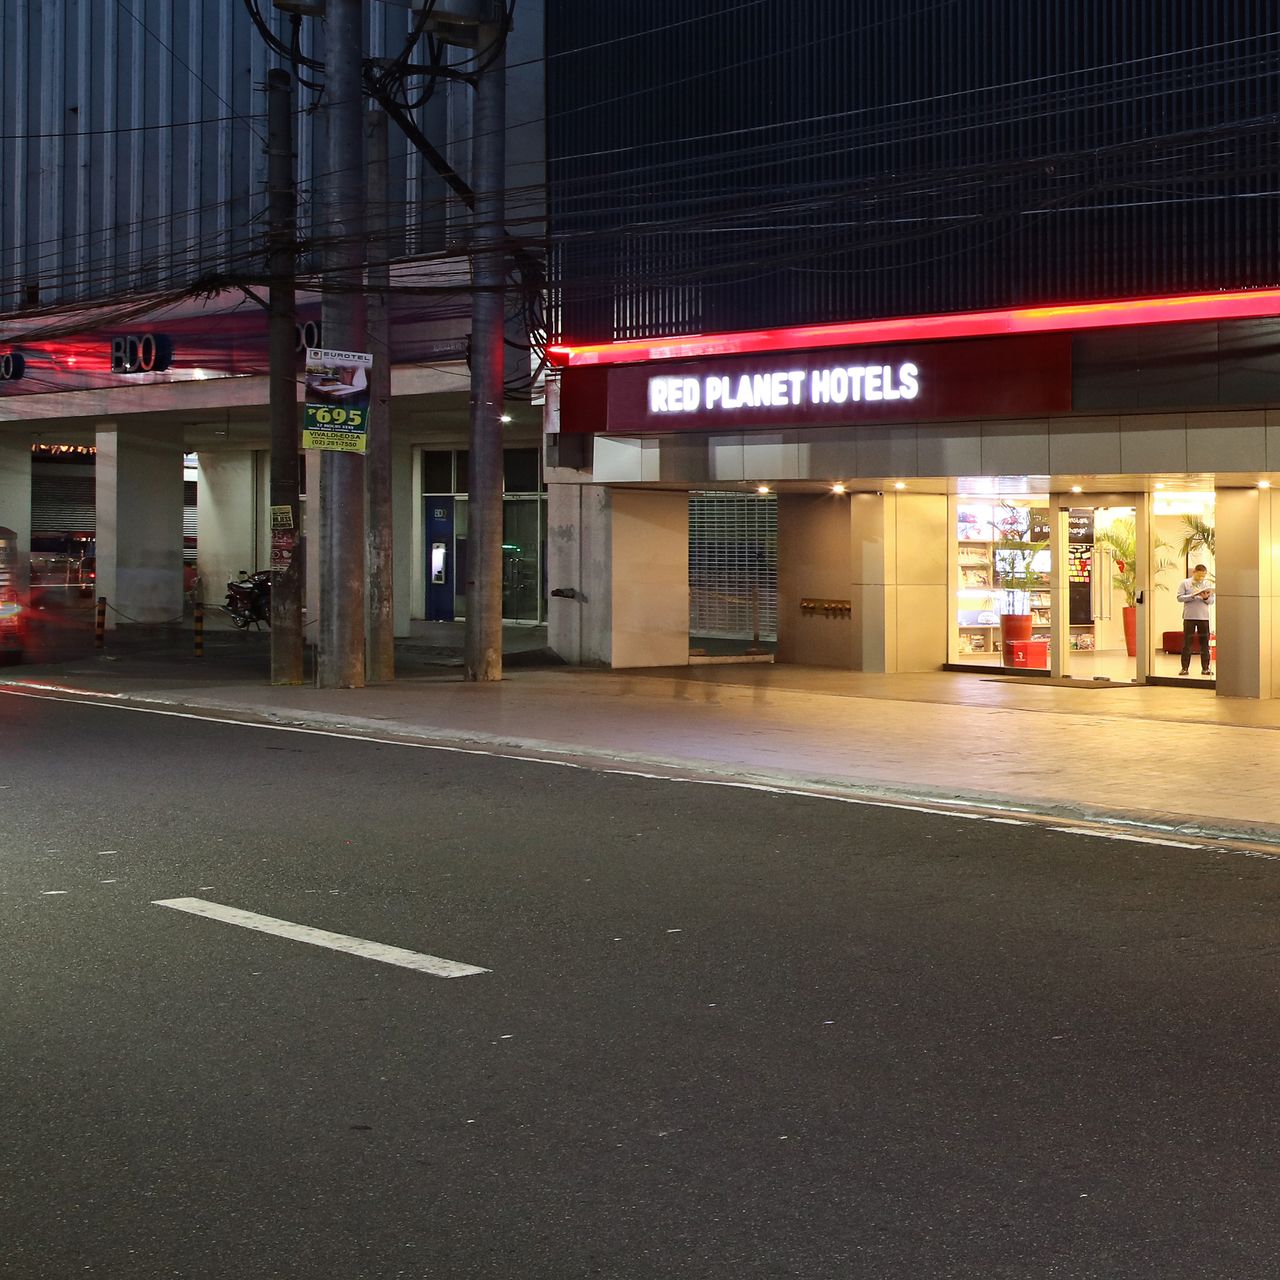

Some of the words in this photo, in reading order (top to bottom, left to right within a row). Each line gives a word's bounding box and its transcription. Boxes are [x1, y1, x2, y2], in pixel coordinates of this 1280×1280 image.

[112, 333, 156, 373] BDO
[323, 351, 371, 361] EUROTEL
[650, 378, 701, 412] RED
[706, 370, 806, 410] PLANET
[811, 362, 920, 404] HOTELS
